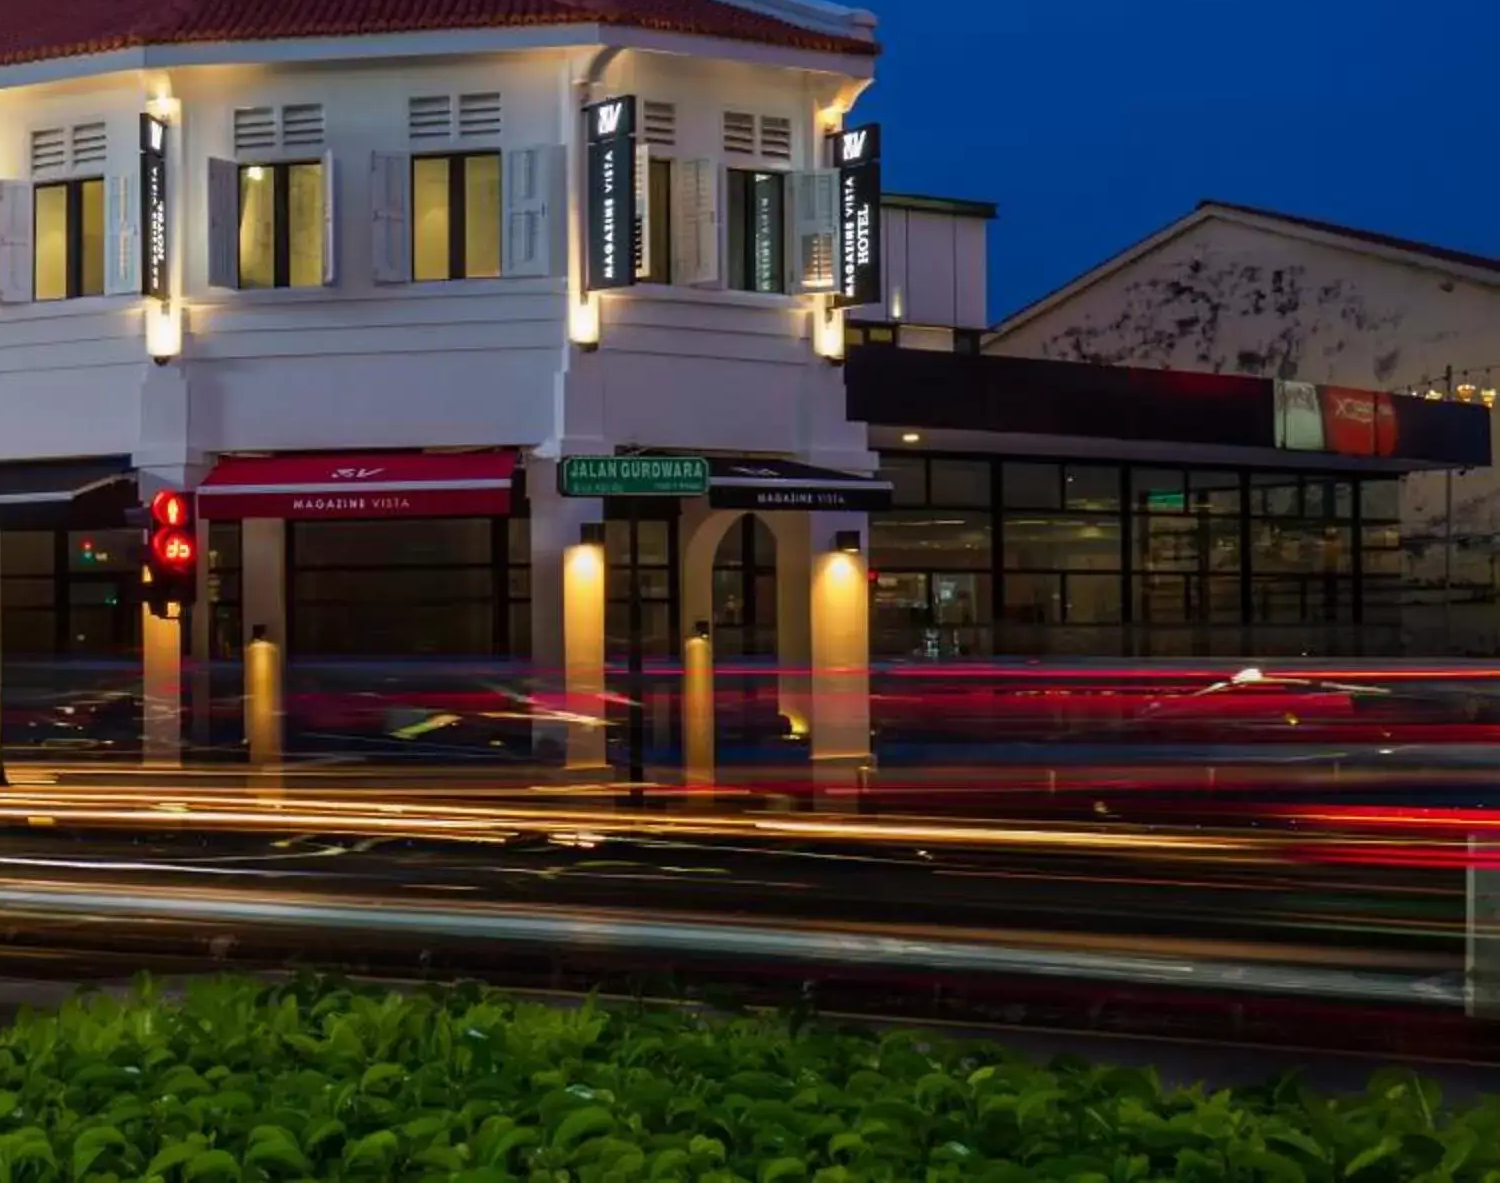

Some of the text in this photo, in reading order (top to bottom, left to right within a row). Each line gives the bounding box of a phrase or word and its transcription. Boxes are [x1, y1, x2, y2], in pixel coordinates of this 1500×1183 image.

[603, 149, 614, 278] MAGAZINE VISTA
[844, 176, 855, 298] MAGAZINE VISTA
[857, 203, 869, 265] HOTEL
[569, 461, 703, 478] JALAN GURDWARA
[293, 497, 410, 510] MAGAZINE VISTA
